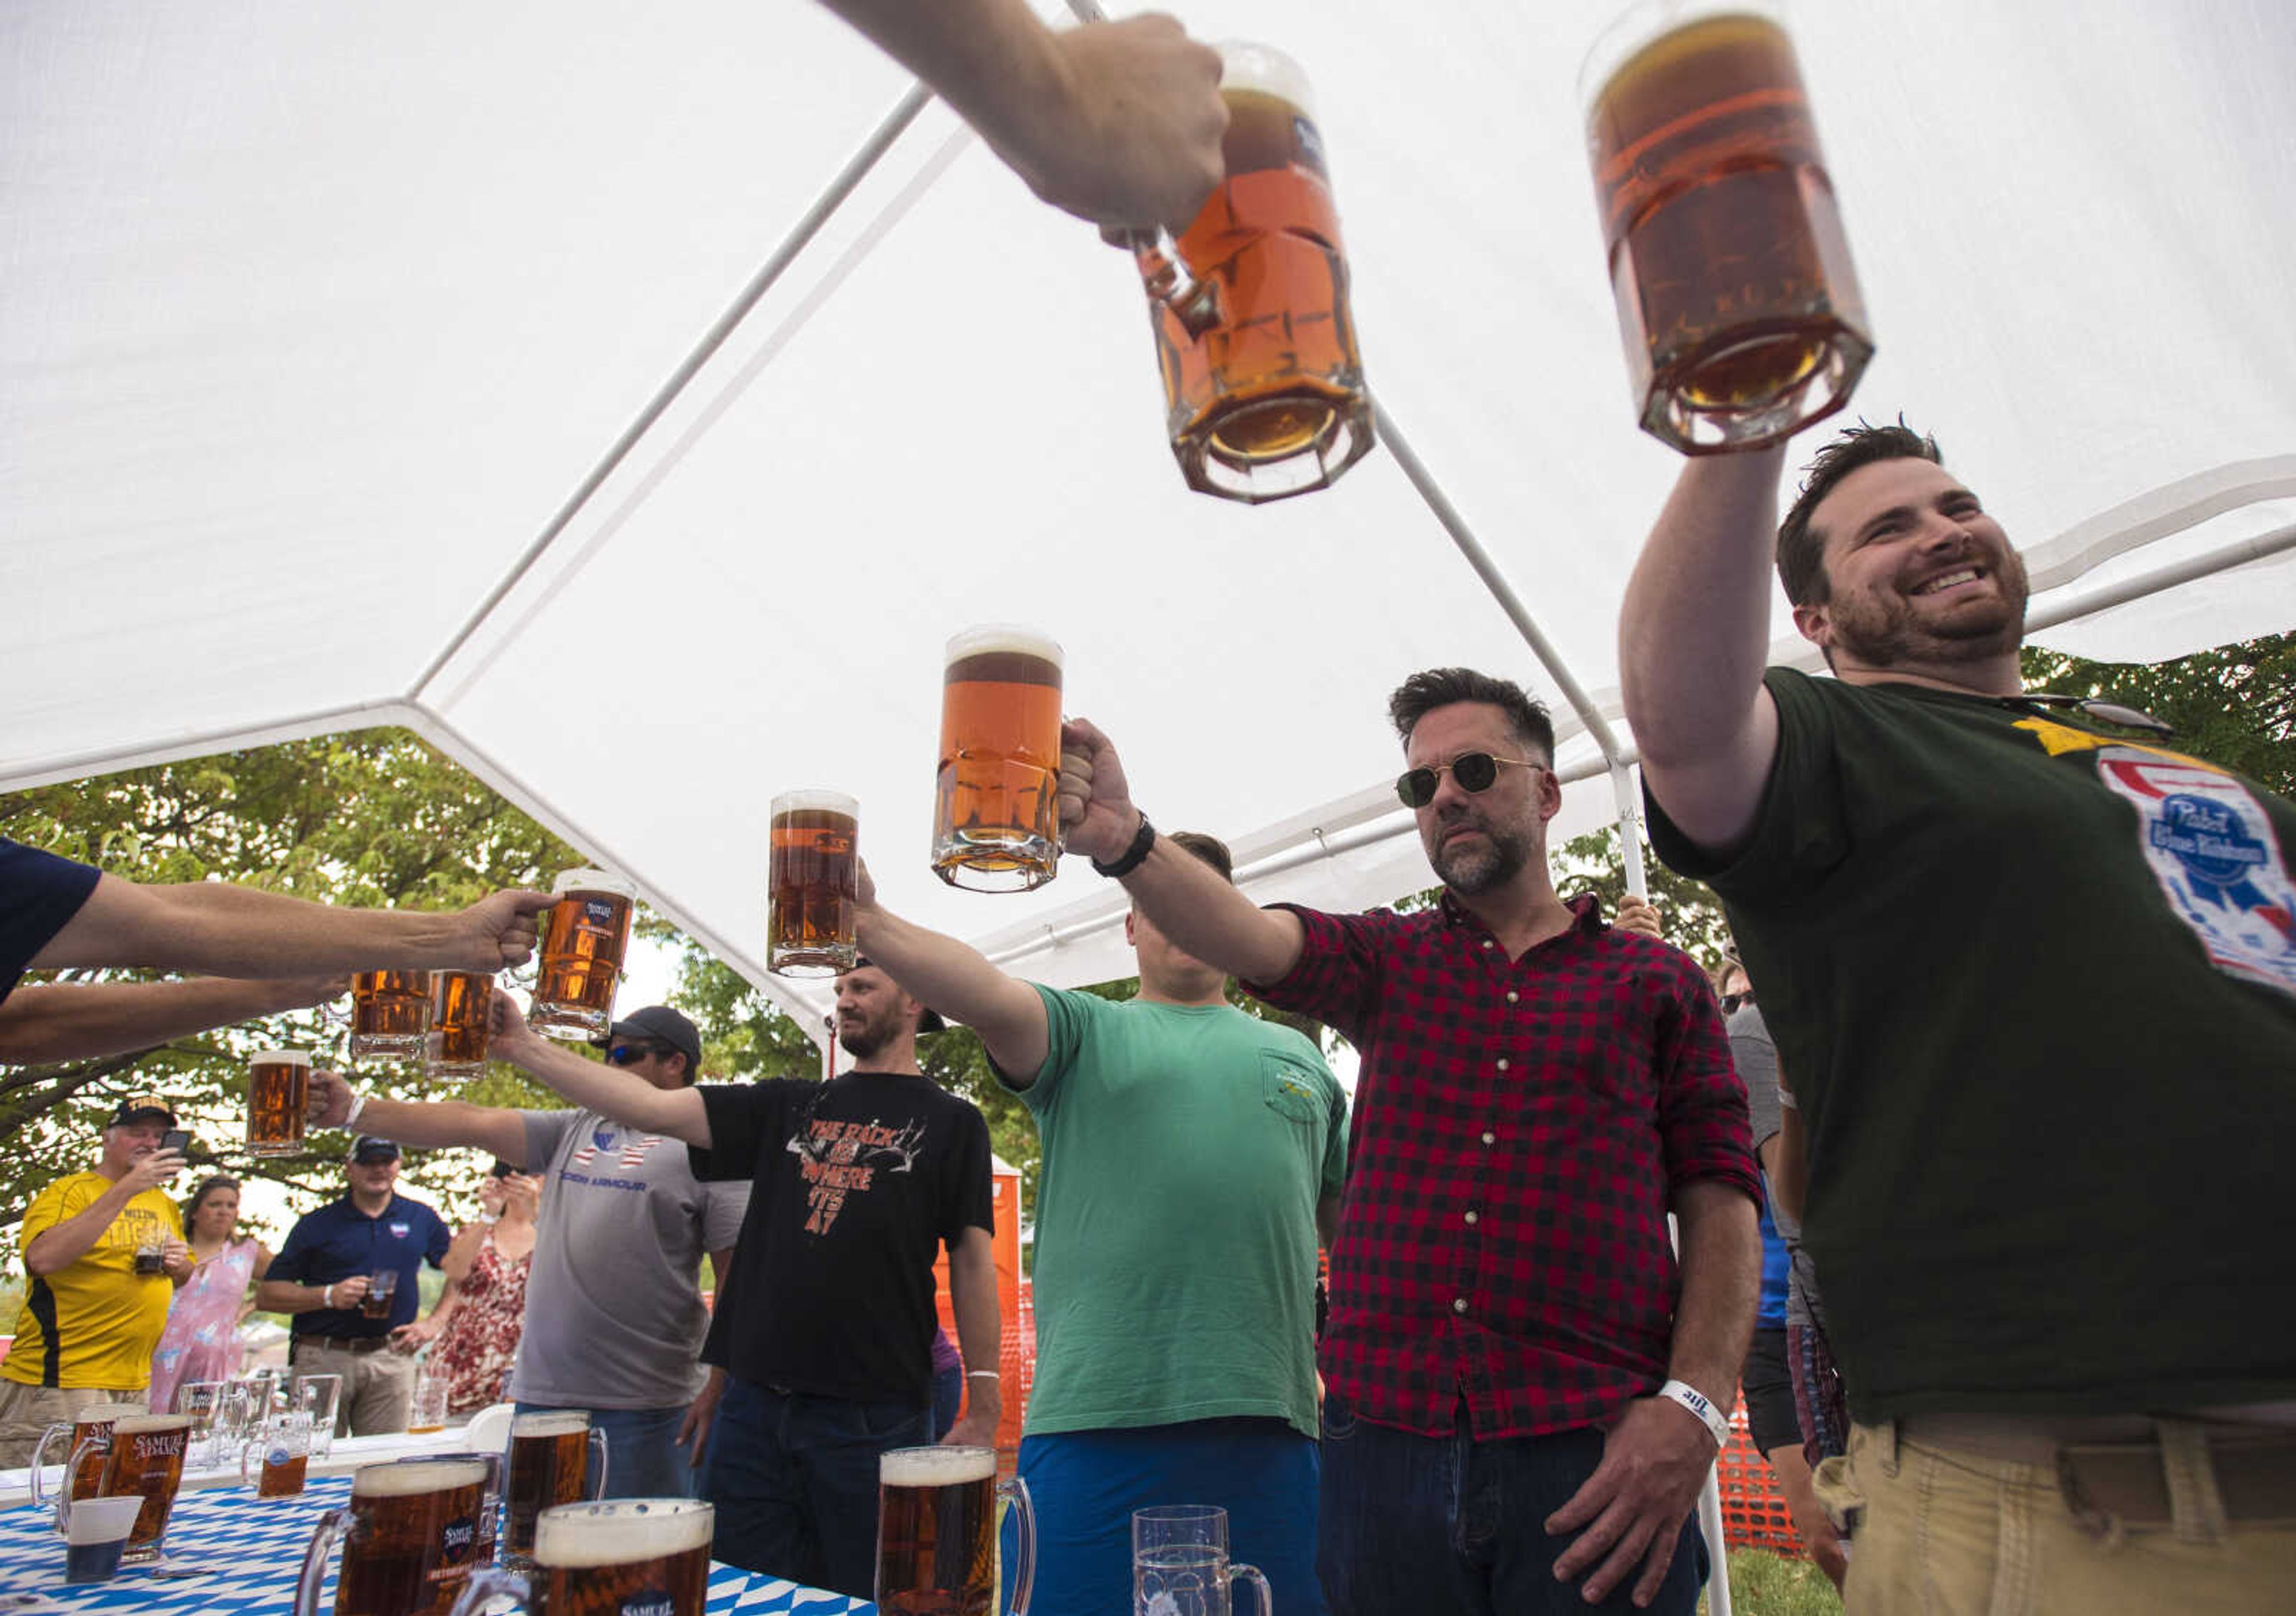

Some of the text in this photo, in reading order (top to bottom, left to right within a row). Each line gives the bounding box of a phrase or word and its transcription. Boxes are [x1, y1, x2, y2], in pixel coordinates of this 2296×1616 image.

[2169, 800, 2229, 834] Pabst
[810, 1120, 845, 1141] THE
[802, 1162, 875, 1191] WHERE
[804, 1209, 838, 1235] AT
[135, 1434, 185, 1449] SAMUEL
